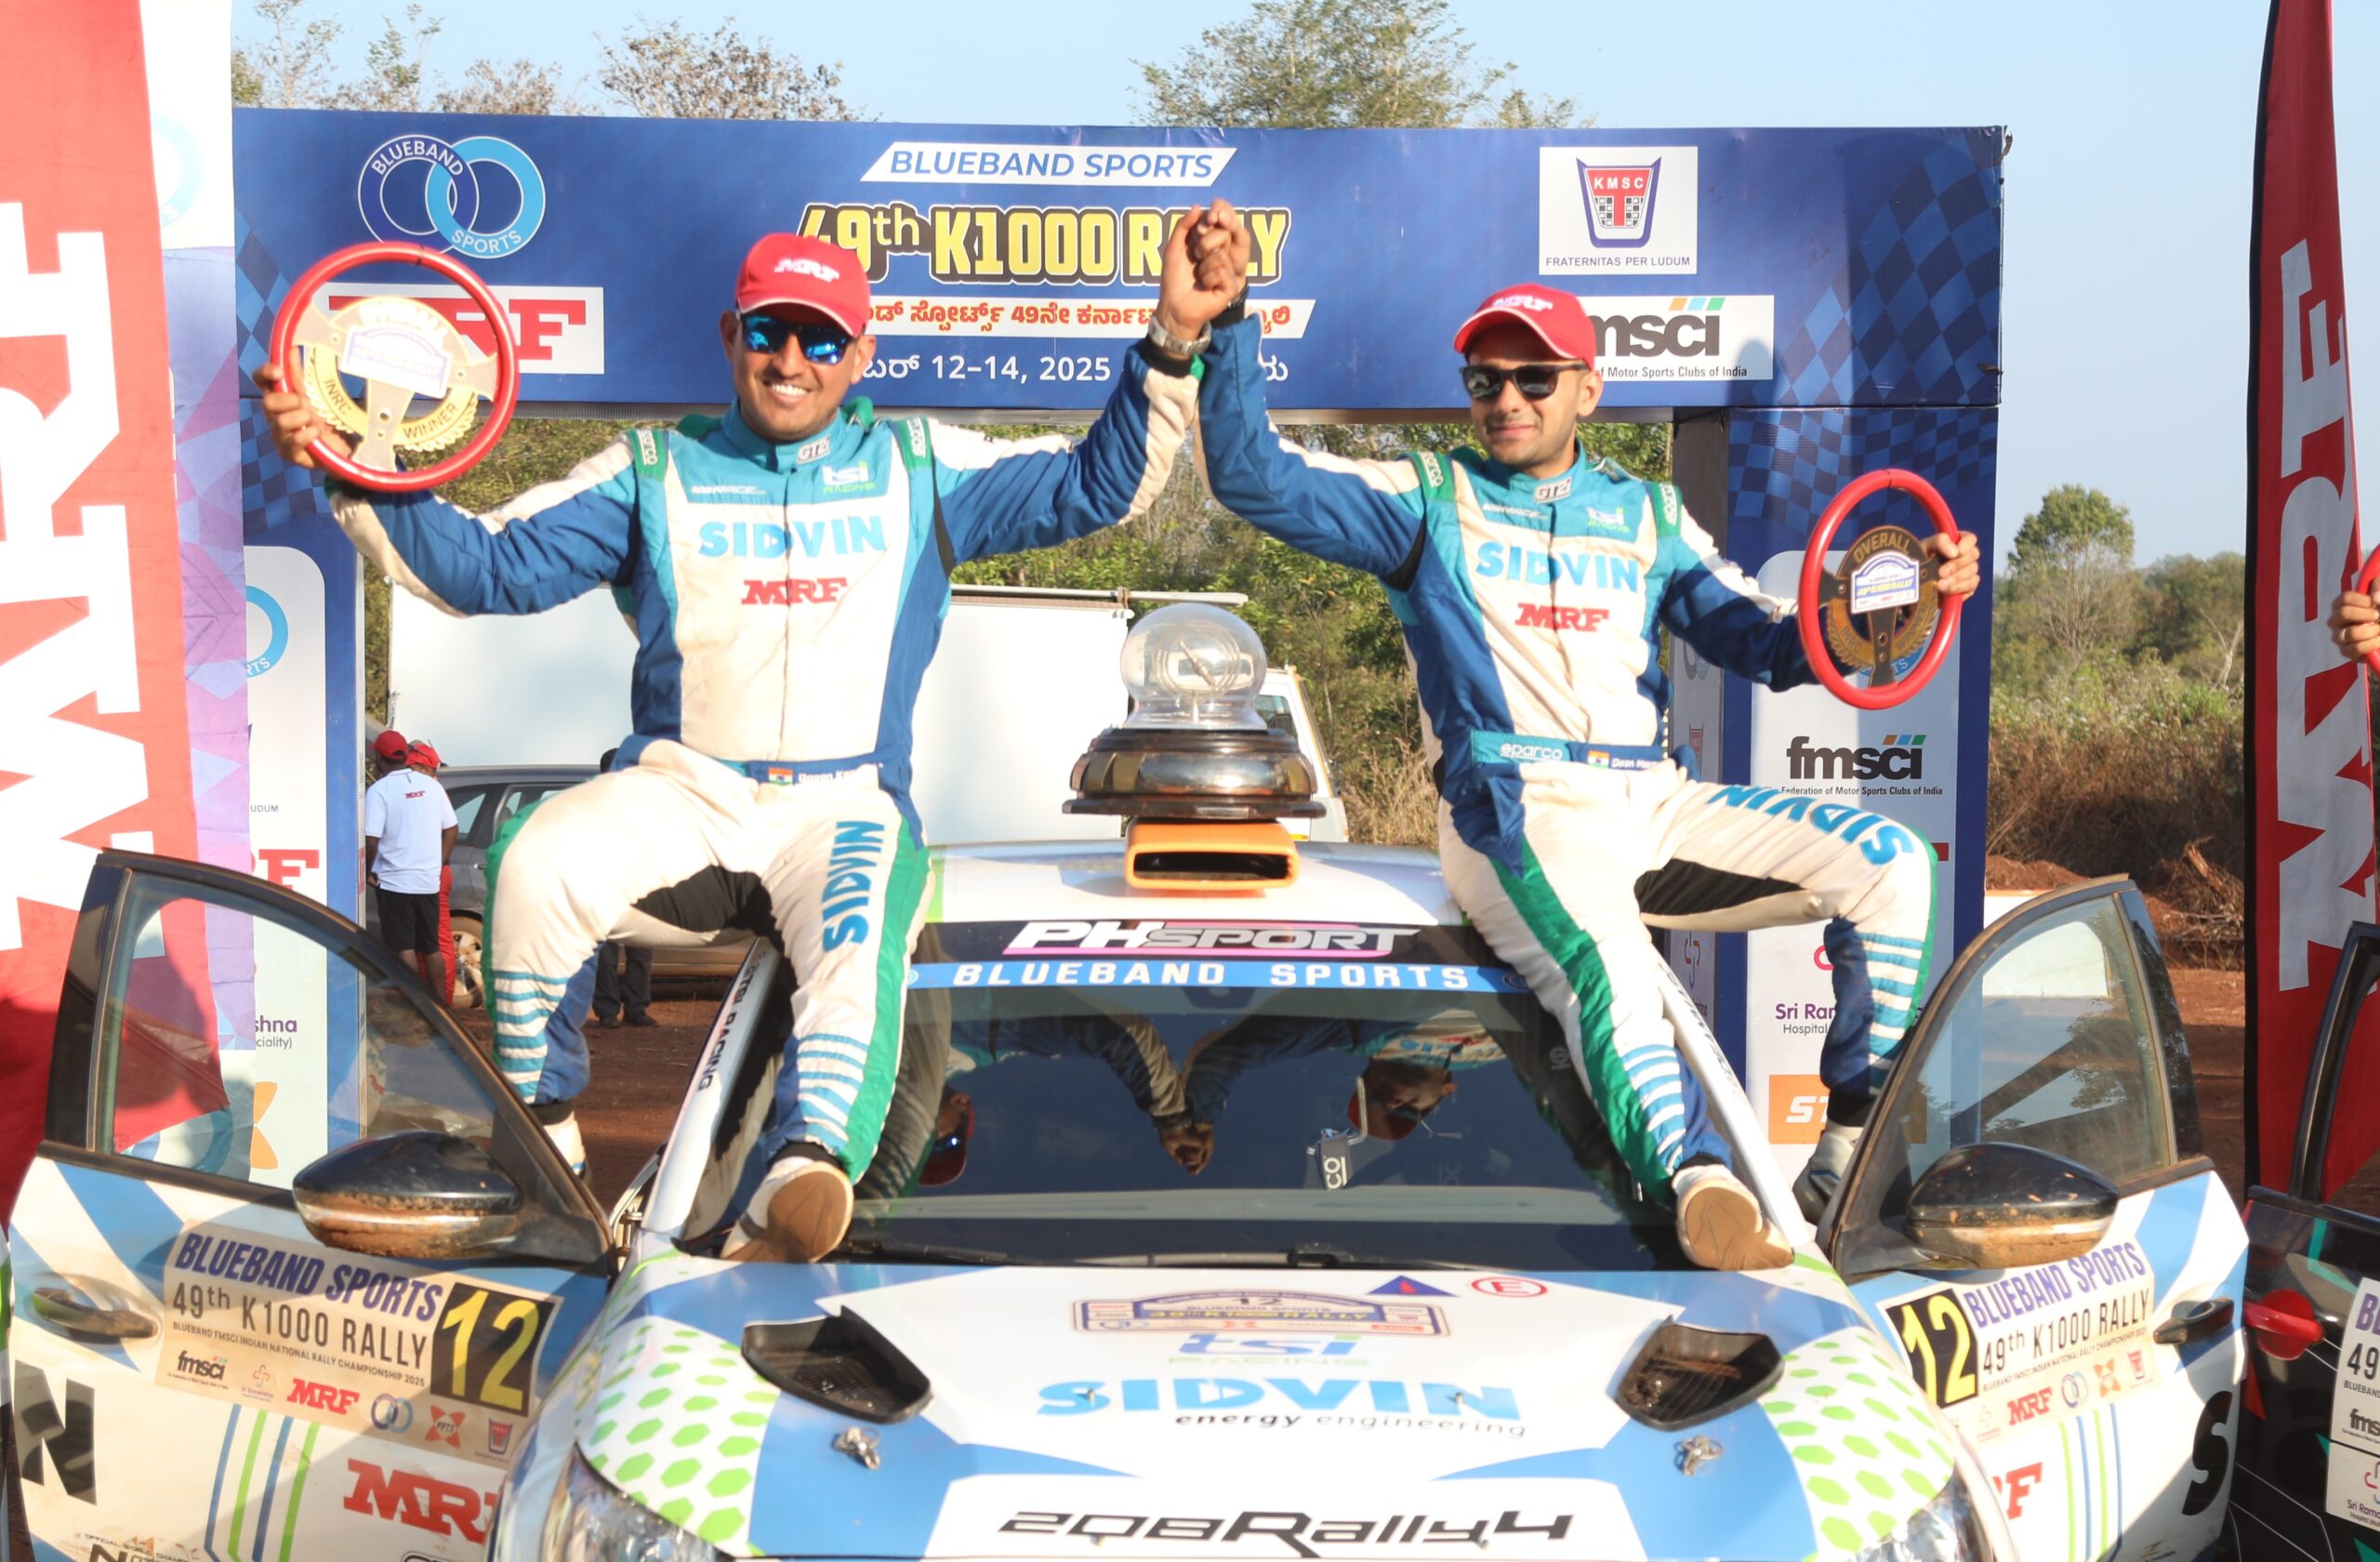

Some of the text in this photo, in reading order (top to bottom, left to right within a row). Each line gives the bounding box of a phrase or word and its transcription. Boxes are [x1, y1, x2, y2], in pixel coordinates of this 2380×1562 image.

[372, 139, 465, 177] BLUEBAND
[890, 150, 1213, 179] BLUEBAND SPORTS
[1593, 176, 1645, 190] KMSC
[451, 229, 522, 254] SPORTS
[934, 208, 1113, 277] K1000
[774, 258, 840, 283] MRF
[1545, 257, 1691, 267] FRATERNITAS PER LUDUM
[1038, 356, 1112, 382] 2025
[1607, 367, 1639, 378] Motor
[1641, 367, 1674, 380] Sports
[1677, 366, 1708, 377] Clubs
[1710, 366, 1721, 377] of
[1722, 366, 1748, 377] India
[324, 378, 352, 417] INRC
[403, 401, 459, 441] WINNER
[822, 460, 869, 483] tsi
[698, 516, 888, 559] SIDVIN
[1853, 531, 1911, 563] OVERALL
[1474, 541, 1640, 593] SIDVIN
[741, 577, 849, 605] MRF
[1514, 602, 1610, 632] MRF
[1786, 735, 1924, 781] fmsci
[248, 804, 279, 814] UDUM
[1781, 786, 1823, 796] Federation
[1825, 786, 1834, 795] of
[1835, 787, 1859, 795] Motor
[1861, 787, 1887, 797] Sports
[1889, 787, 1911, 795] Clubs
[1913, 786, 1923, 795] of
[1924, 786, 1943, 796] India
[1707, 784, 1916, 867] SIDVIN
[821, 820, 886, 953] SIDVIN
[952, 961, 1471, 990] BLUEBAND SPORTS
[1775, 1002, 1802, 1021] Sri
[1782, 1022, 1829, 1038] Hospital
[174, 1232, 443, 1322] BLUEBAND SPORTS
[1963, 1241, 2148, 1330] BLUEBAND SPORTS
[172, 1281, 429, 1370] 49th K1000 RALLY
[1179, 1331, 1362, 1356] tsi
[1982, 1287, 2151, 1376] 49th K1000 RALLY
[173, 1320, 425, 1387] BLUEBAND FMSCI INDIAN NATIONAL RALLY CHAMPIONSHIP 2025
[177, 1349, 227, 1381] fmsci
[440, 1289, 541, 1412] 12
[1902, 1293, 1977, 1405] 12
[286, 1377, 361, 1416] MRF
[1036, 1376, 1523, 1422] SIDVIN
[2006, 1385, 2054, 1426] MRF
[1174, 1412, 1527, 1439] energy engineering
[343, 1457, 498, 1546] MR
